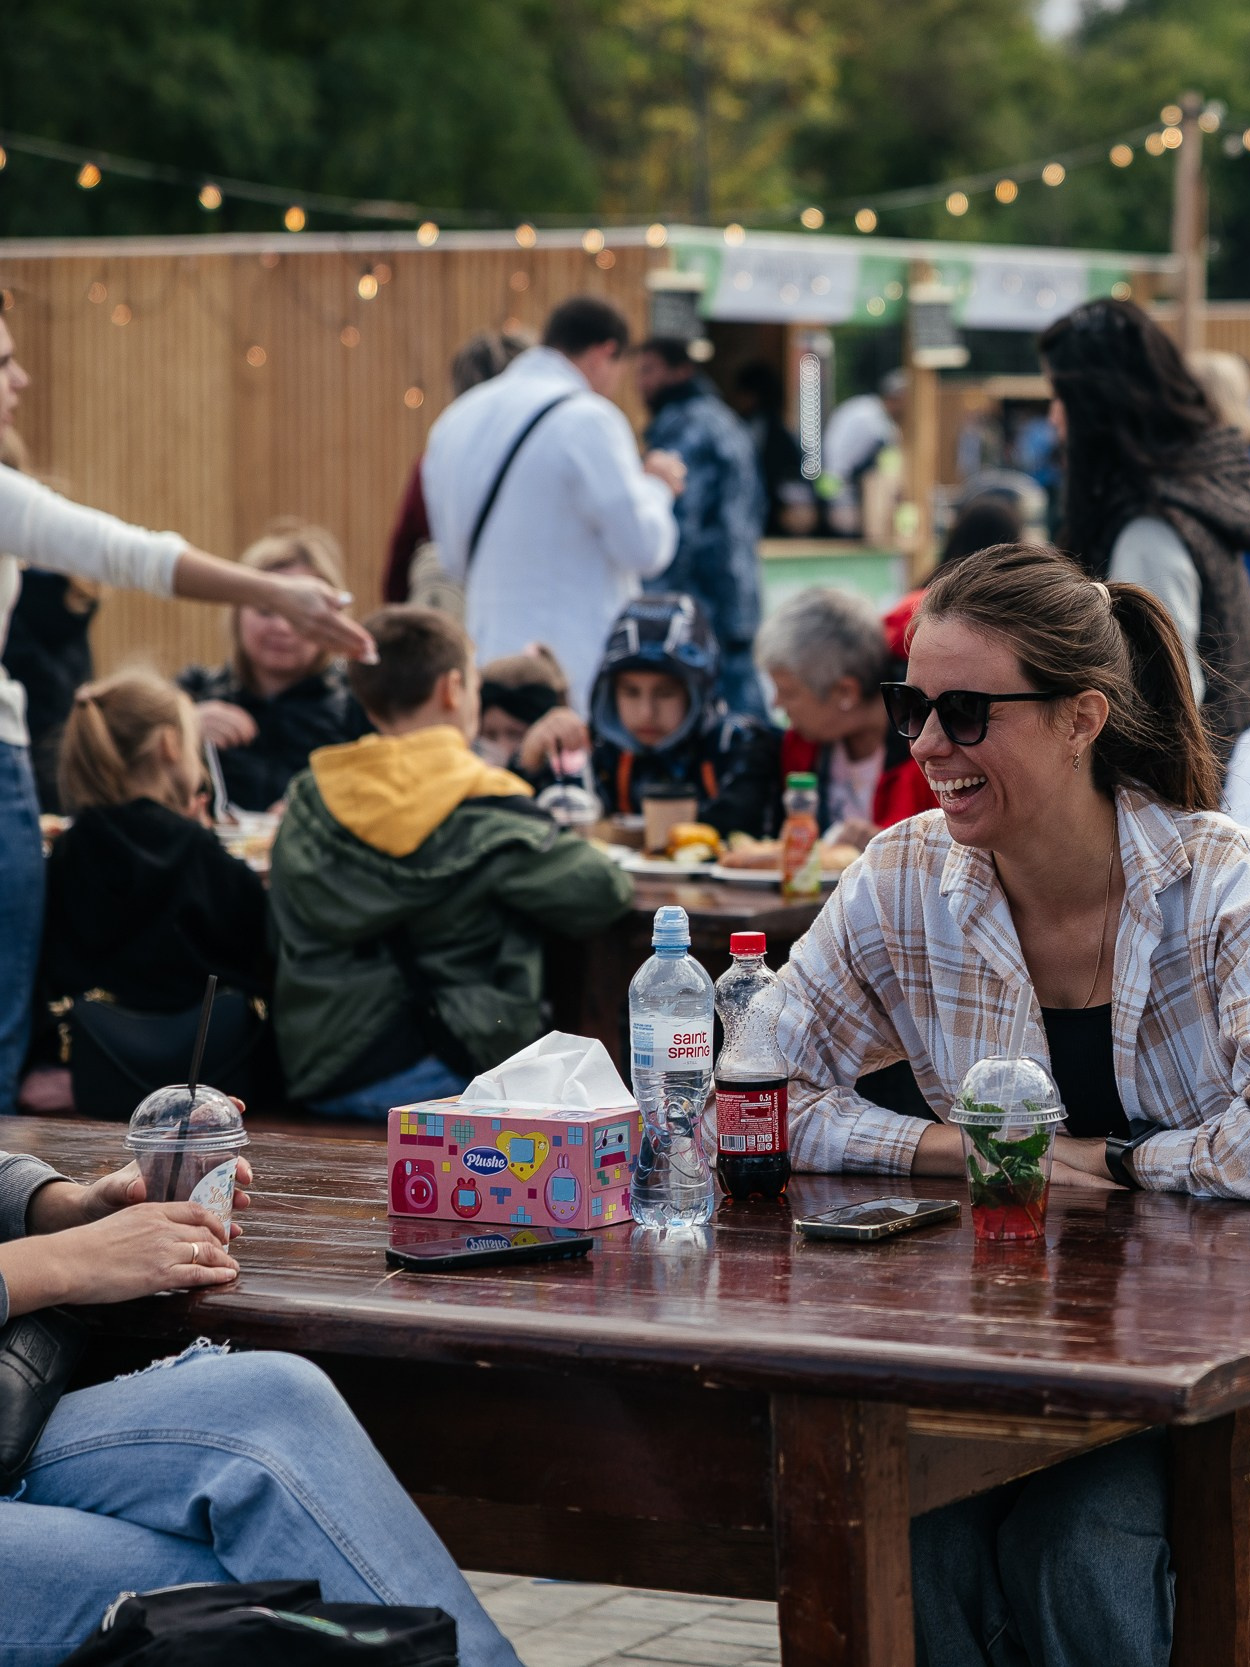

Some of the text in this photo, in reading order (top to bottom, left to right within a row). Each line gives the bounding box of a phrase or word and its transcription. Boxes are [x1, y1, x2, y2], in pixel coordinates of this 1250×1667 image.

[673, 1032, 707, 1045] saint
[668, 1045, 710, 1059] SPRING
[466, 1153, 506, 1169] Plushe
